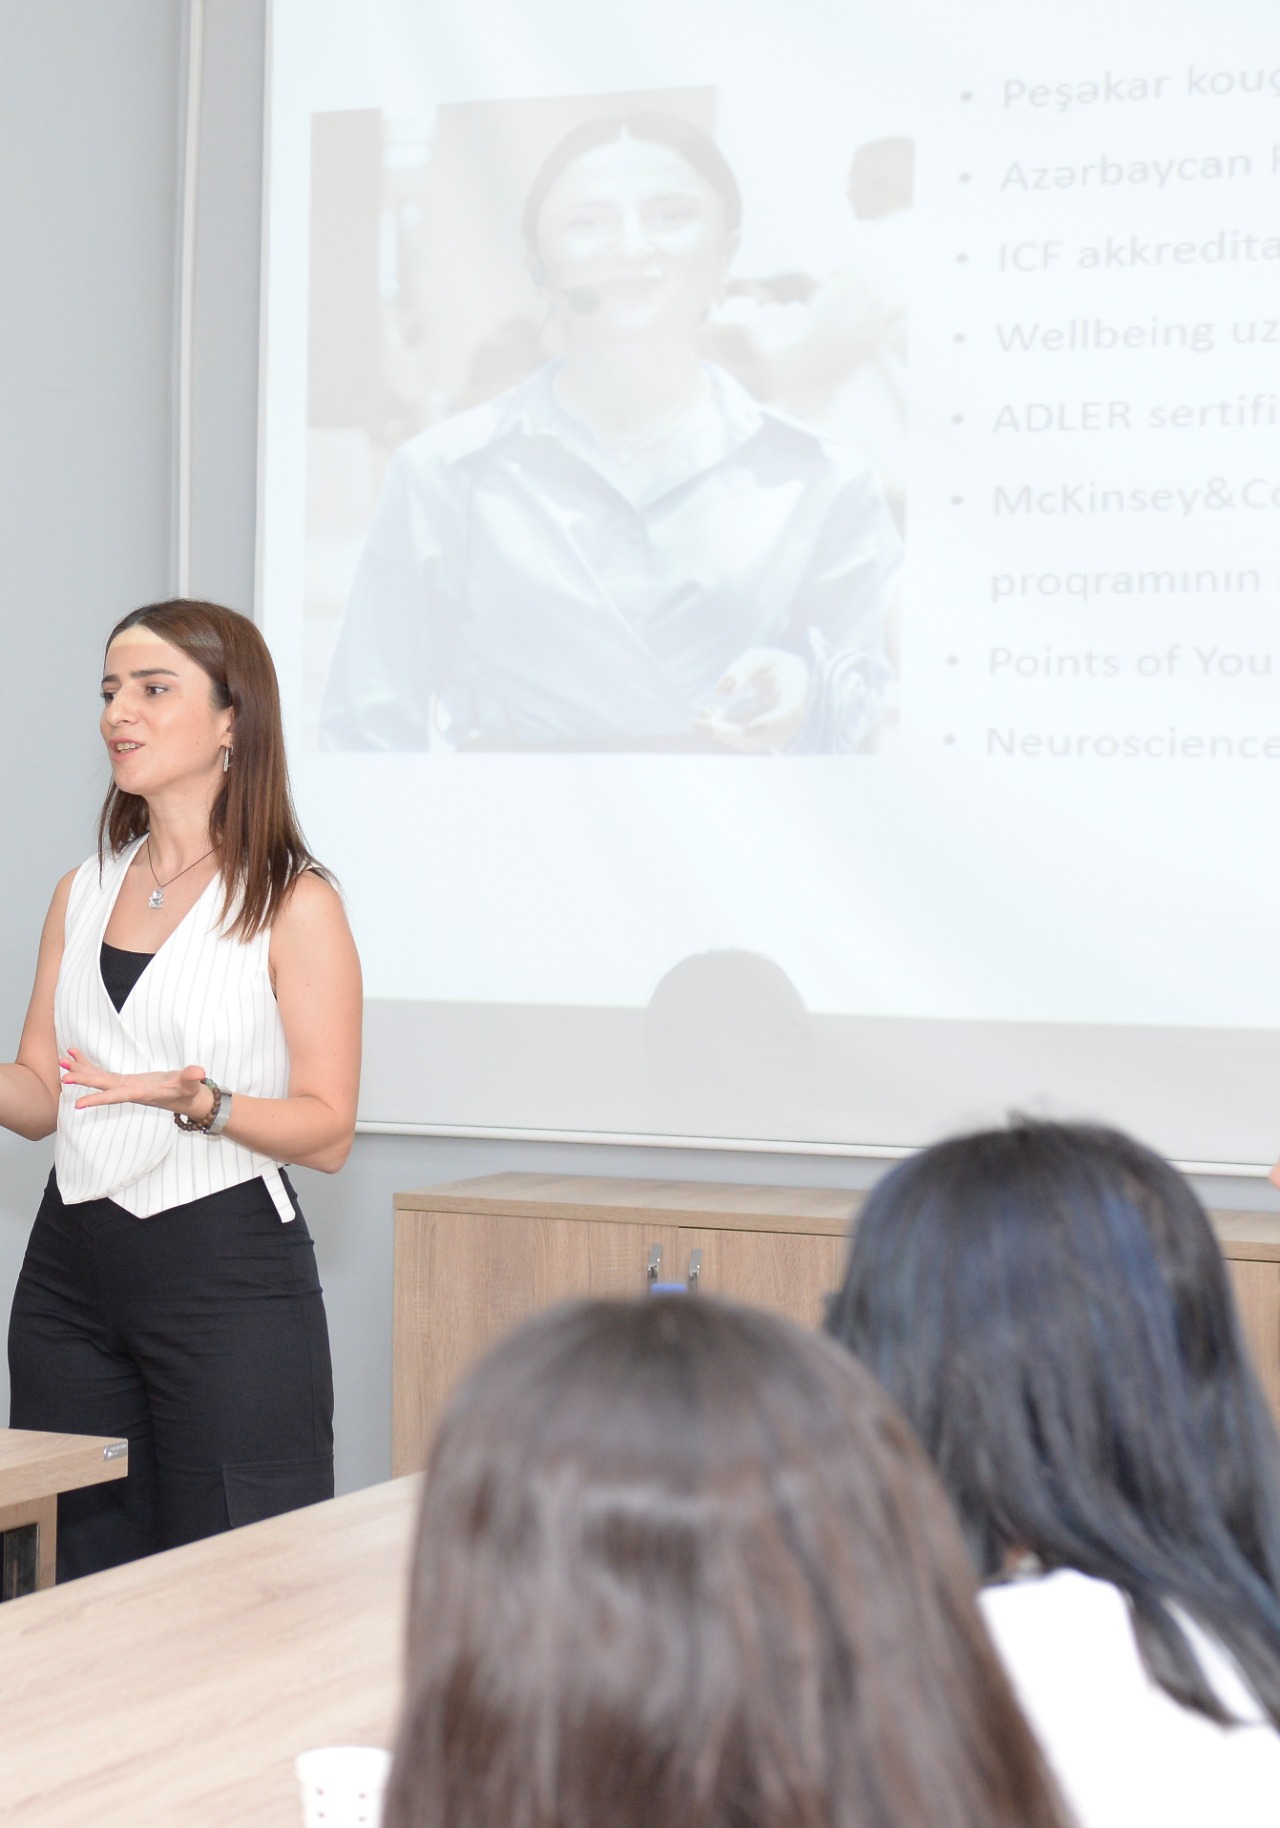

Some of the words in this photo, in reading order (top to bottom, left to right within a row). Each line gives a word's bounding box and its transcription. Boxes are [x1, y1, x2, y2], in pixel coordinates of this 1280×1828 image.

[1003, 70, 1172, 112] Peşəkar
[1000, 153, 1253, 192] Azərbaycan
[998, 239, 1063, 272] ICF
[1077, 228, 1280, 269] akkredita
[995, 315, 1216, 353] Wellbeing
[991, 400, 1133, 433] ADLER
[1148, 393, 1277, 429] sertifi
[990, 568, 1262, 603] proqramının
[989, 644, 1121, 677] Points
[1136, 643, 1182, 677] of
[1193, 645, 1273, 677] You
[985, 725, 1280, 758] Neuroscience
